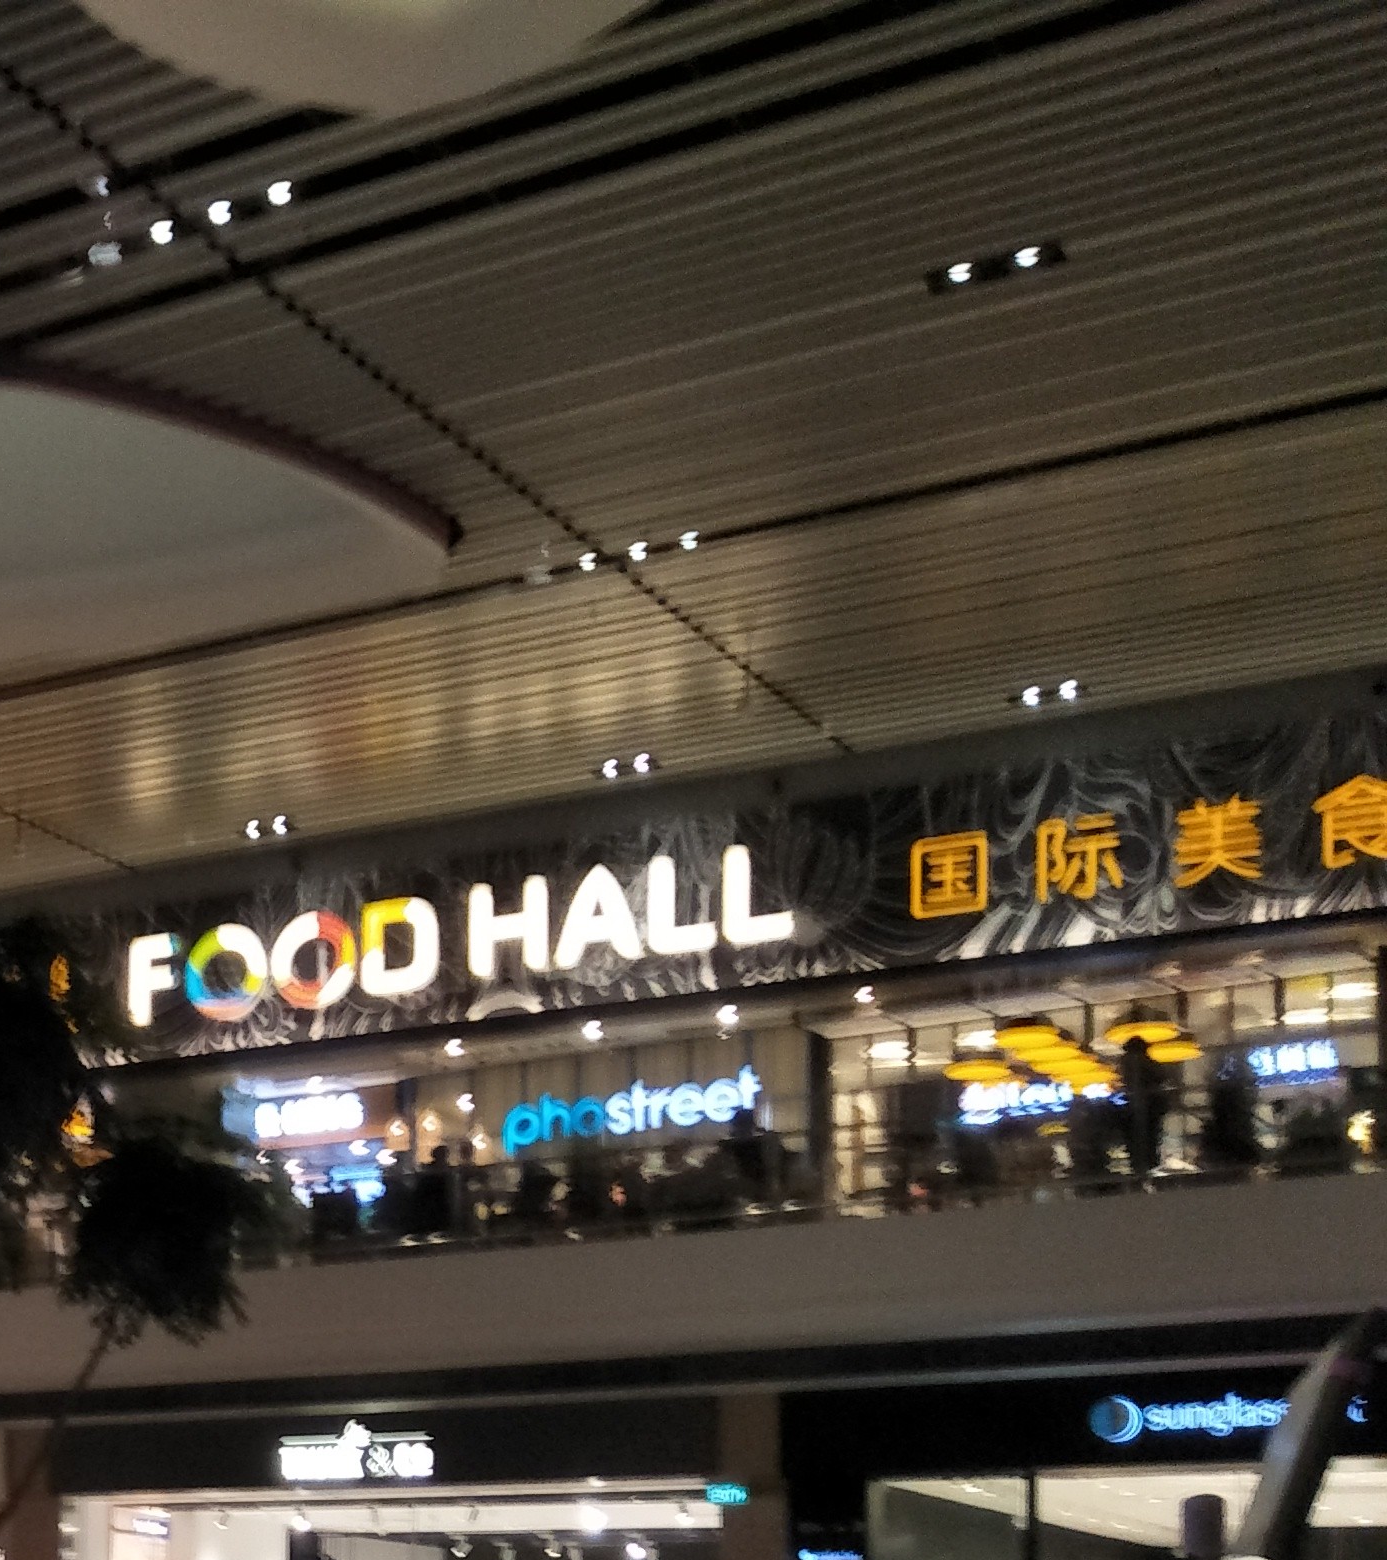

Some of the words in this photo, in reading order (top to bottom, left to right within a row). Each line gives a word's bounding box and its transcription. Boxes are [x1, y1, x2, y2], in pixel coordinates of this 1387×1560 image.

[910, 774, 1387, 920] 国际美食
[128, 896, 441, 1028] FOOD
[467, 843, 795, 979] HALL
[503, 1064, 763, 1158] phostreet
